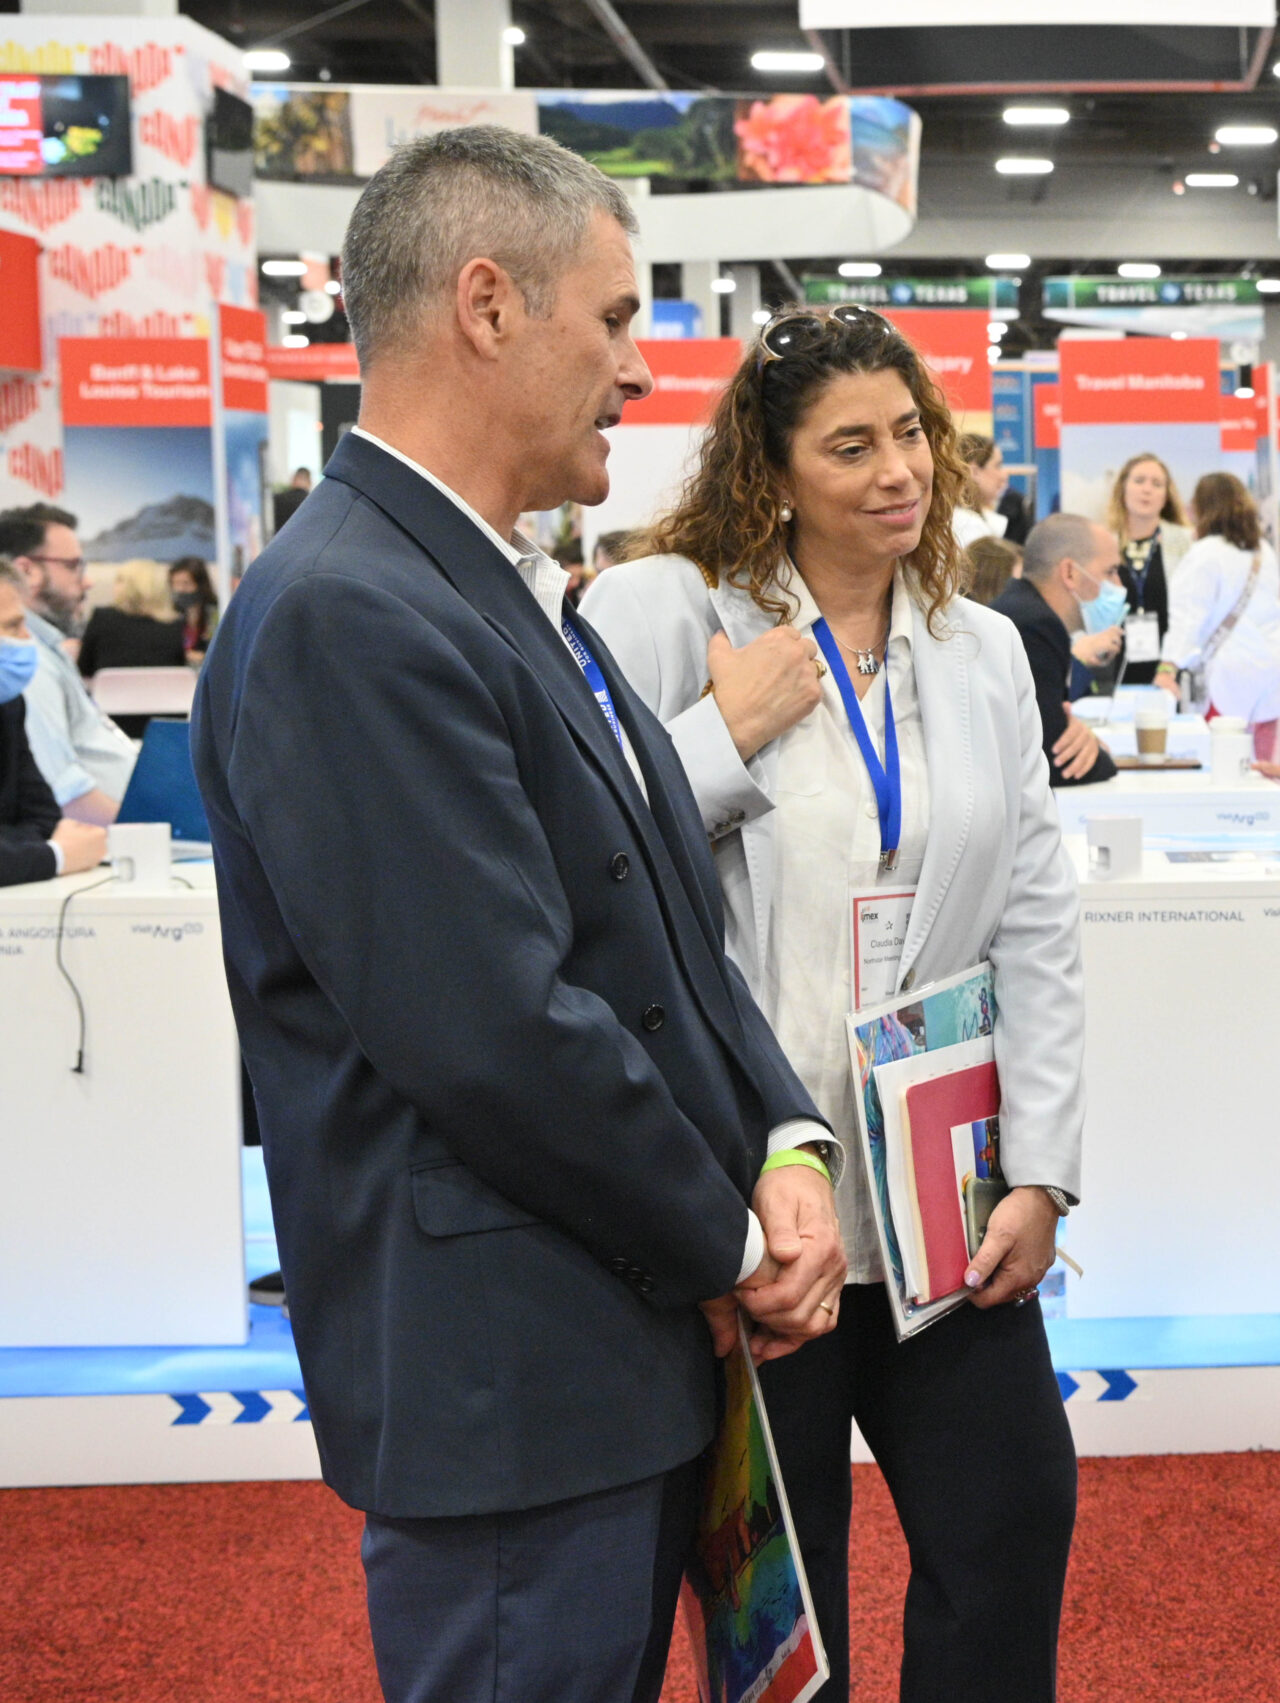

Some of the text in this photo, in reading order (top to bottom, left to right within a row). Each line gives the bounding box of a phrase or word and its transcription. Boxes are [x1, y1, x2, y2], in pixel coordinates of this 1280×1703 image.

[914, 286, 967, 302] TEXAS
[1096, 284, 1237, 302] TRAVEL TEXAS
[90, 364, 138, 381] Banff
[155, 365, 199, 381] Lake
[1075, 374, 1205, 390] Travel Manitoba
[79, 382, 211, 399] Louise Tourism
[562, 626, 587, 668] UNITED
[1085, 911, 1246, 923] RIXNER INTERNATIONAL
[870, 938, 893, 949] Claudia
